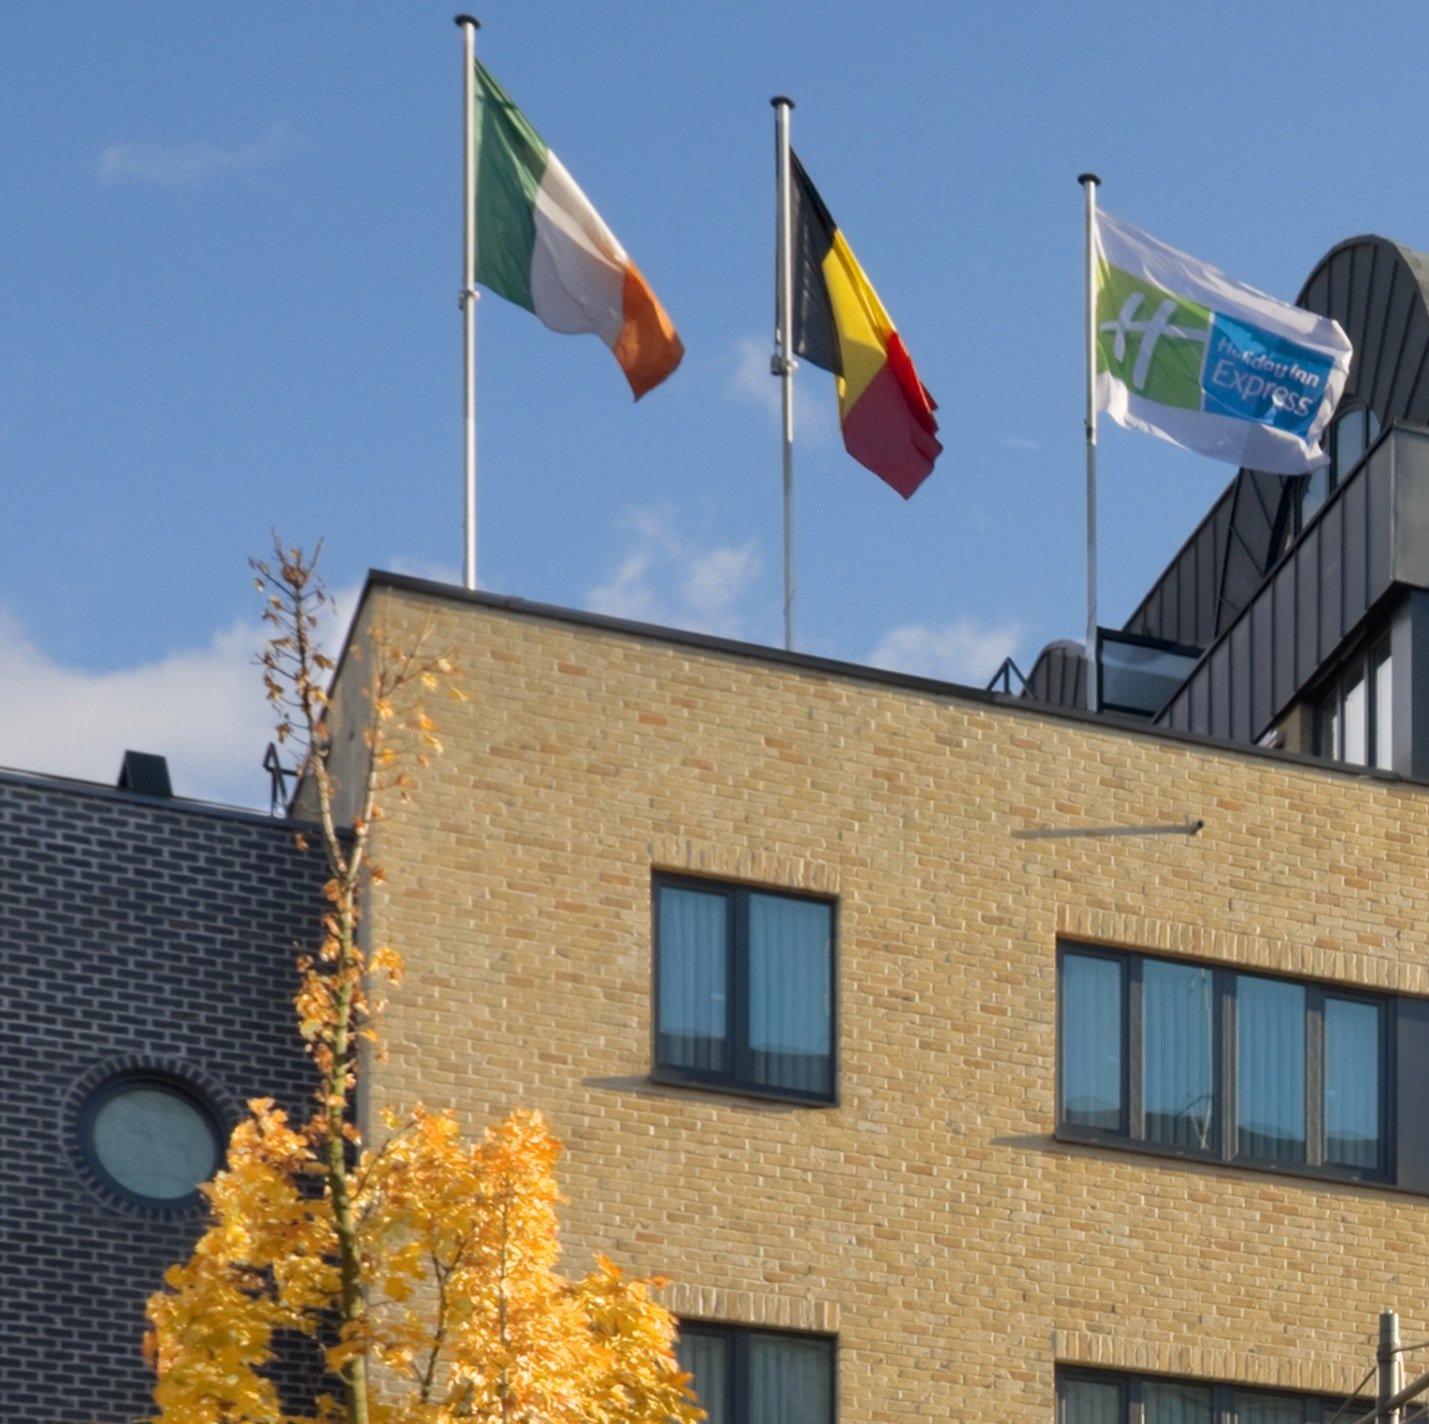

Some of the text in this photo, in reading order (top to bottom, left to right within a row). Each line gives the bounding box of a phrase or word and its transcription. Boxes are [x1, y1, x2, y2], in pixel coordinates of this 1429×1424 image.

[1211, 358, 1314, 418] Express
[1217, 335, 1320, 388] Holiday Inn
